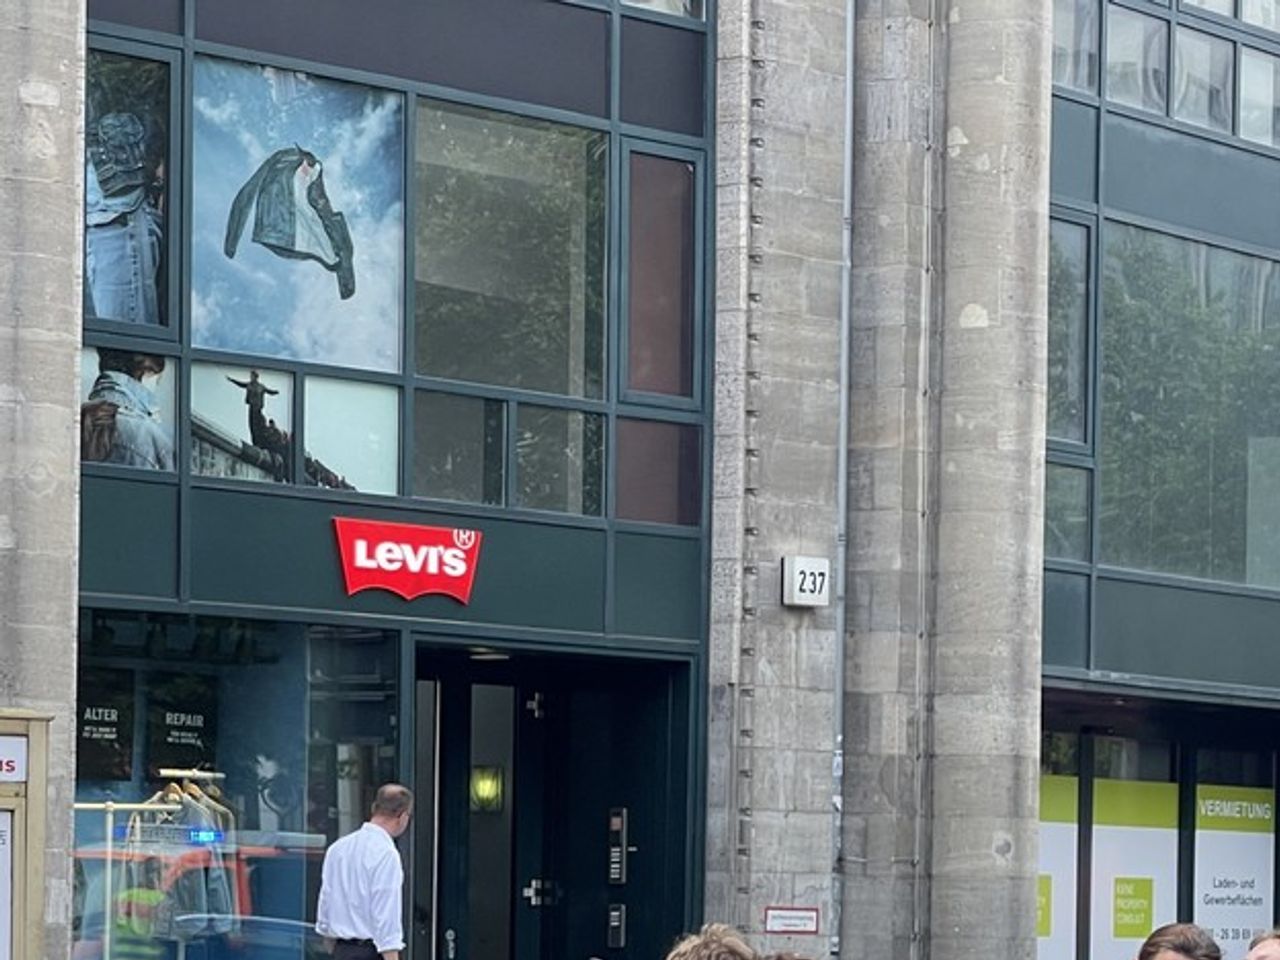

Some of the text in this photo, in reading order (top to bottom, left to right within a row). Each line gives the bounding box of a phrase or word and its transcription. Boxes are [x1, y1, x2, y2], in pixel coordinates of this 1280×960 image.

[799, 570, 826, 595] 237
[84, 707, 118, 721] ALTER
[166, 712, 204, 727] REPAIR
[1200, 800, 1271, 819] VERMIETUNG
